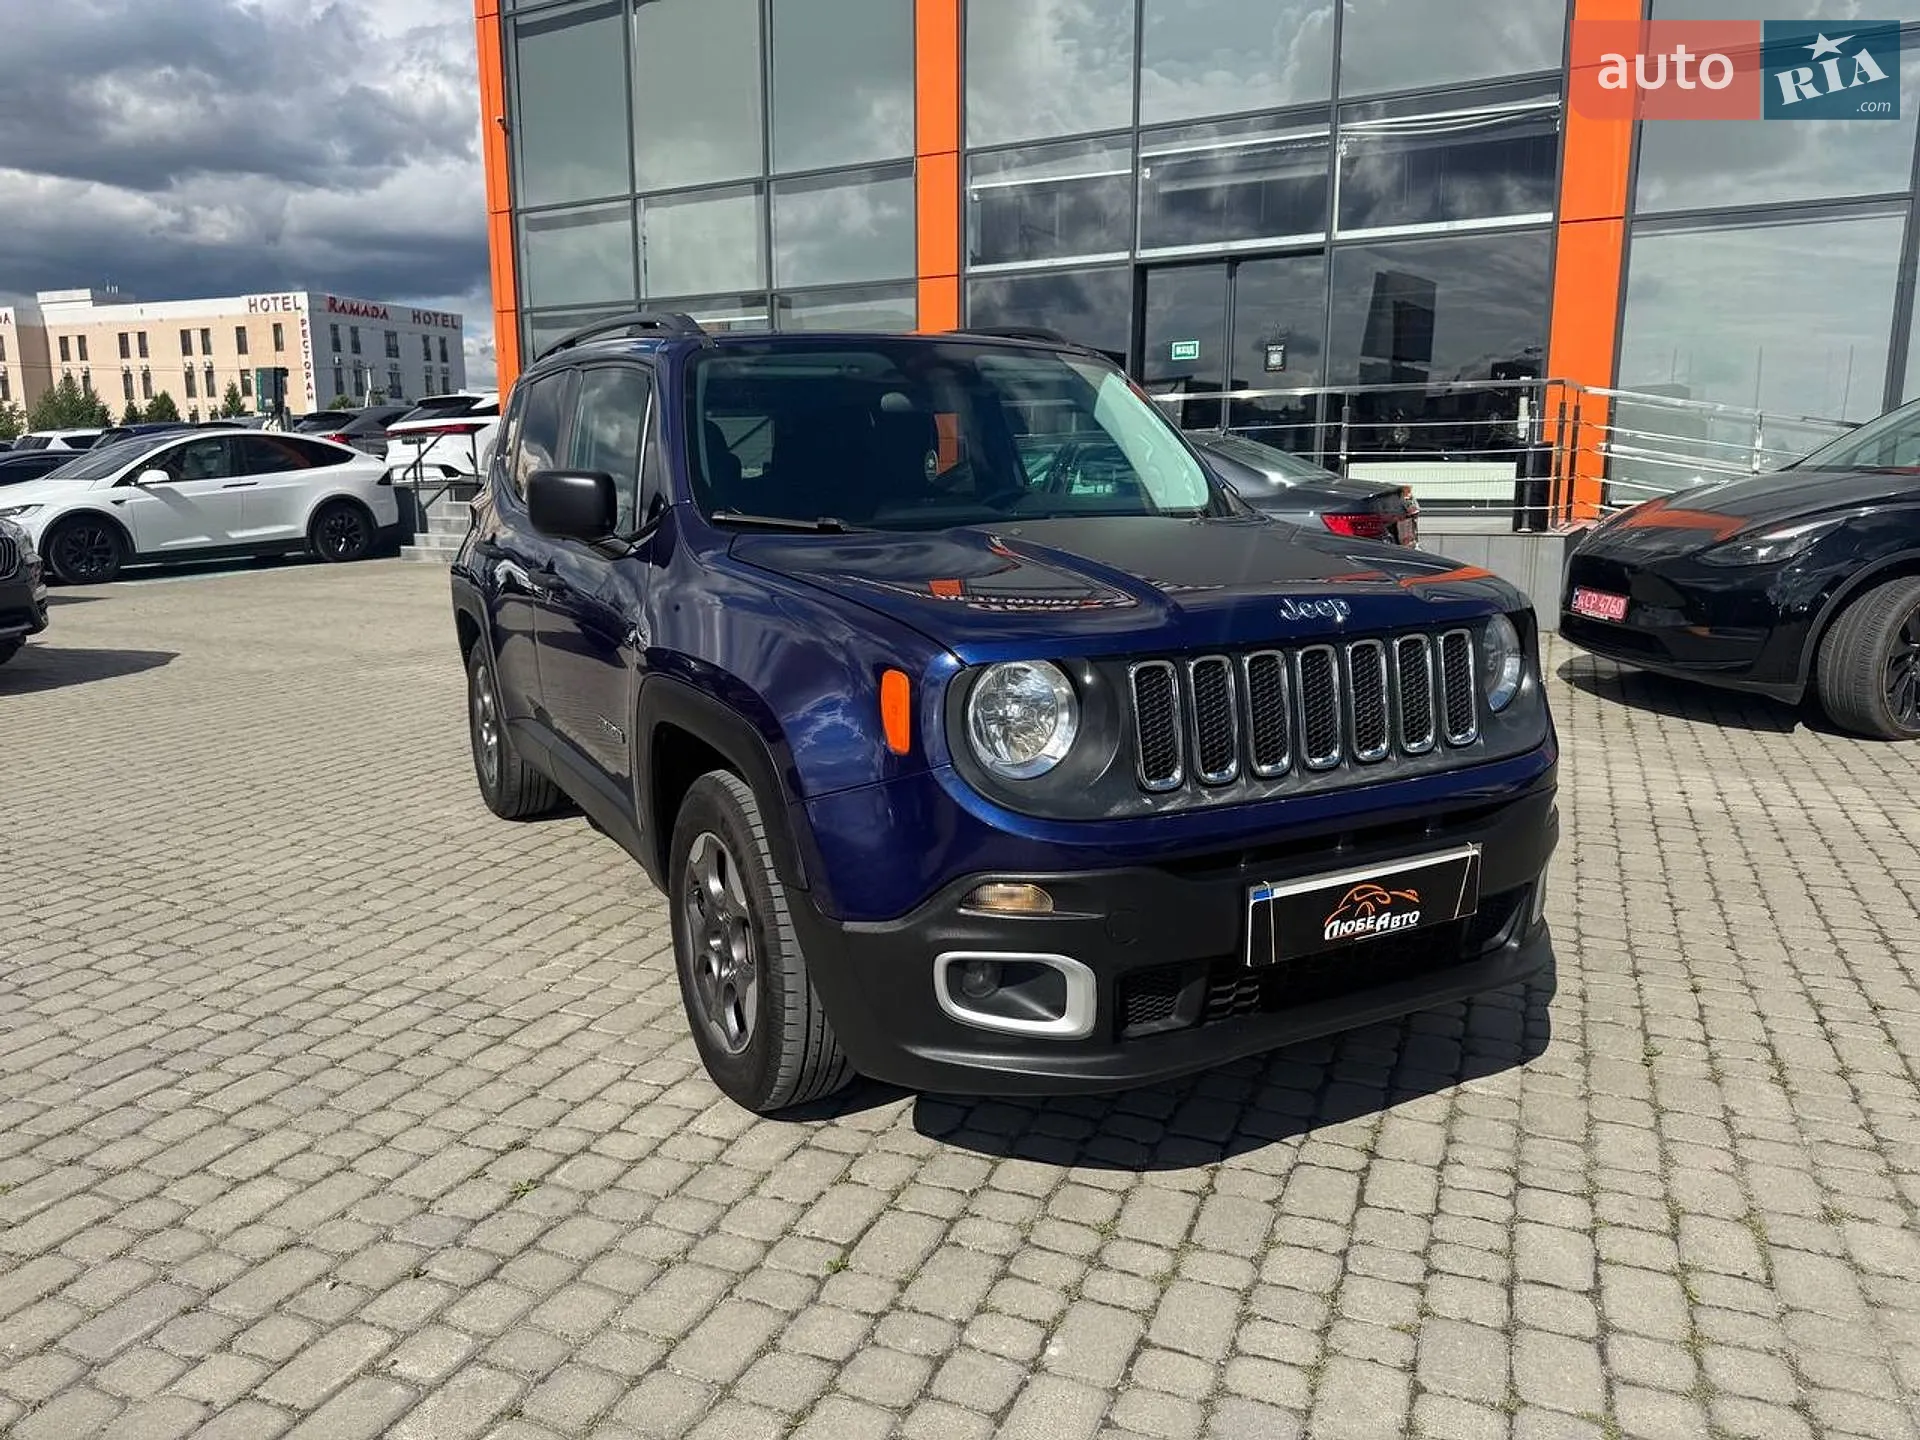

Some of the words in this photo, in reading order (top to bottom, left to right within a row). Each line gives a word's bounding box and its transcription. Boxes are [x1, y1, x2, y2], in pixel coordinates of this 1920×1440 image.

[248, 296, 301, 313] HOTEL
[327, 296, 389, 321] RAMADA
[411, 309, 459, 330] HOTEL
[300, 318, 314, 401] РЕСТОРАН
[1280, 598, 1352, 622] Jeep
[1599, 595, 1626, 615] 4760
